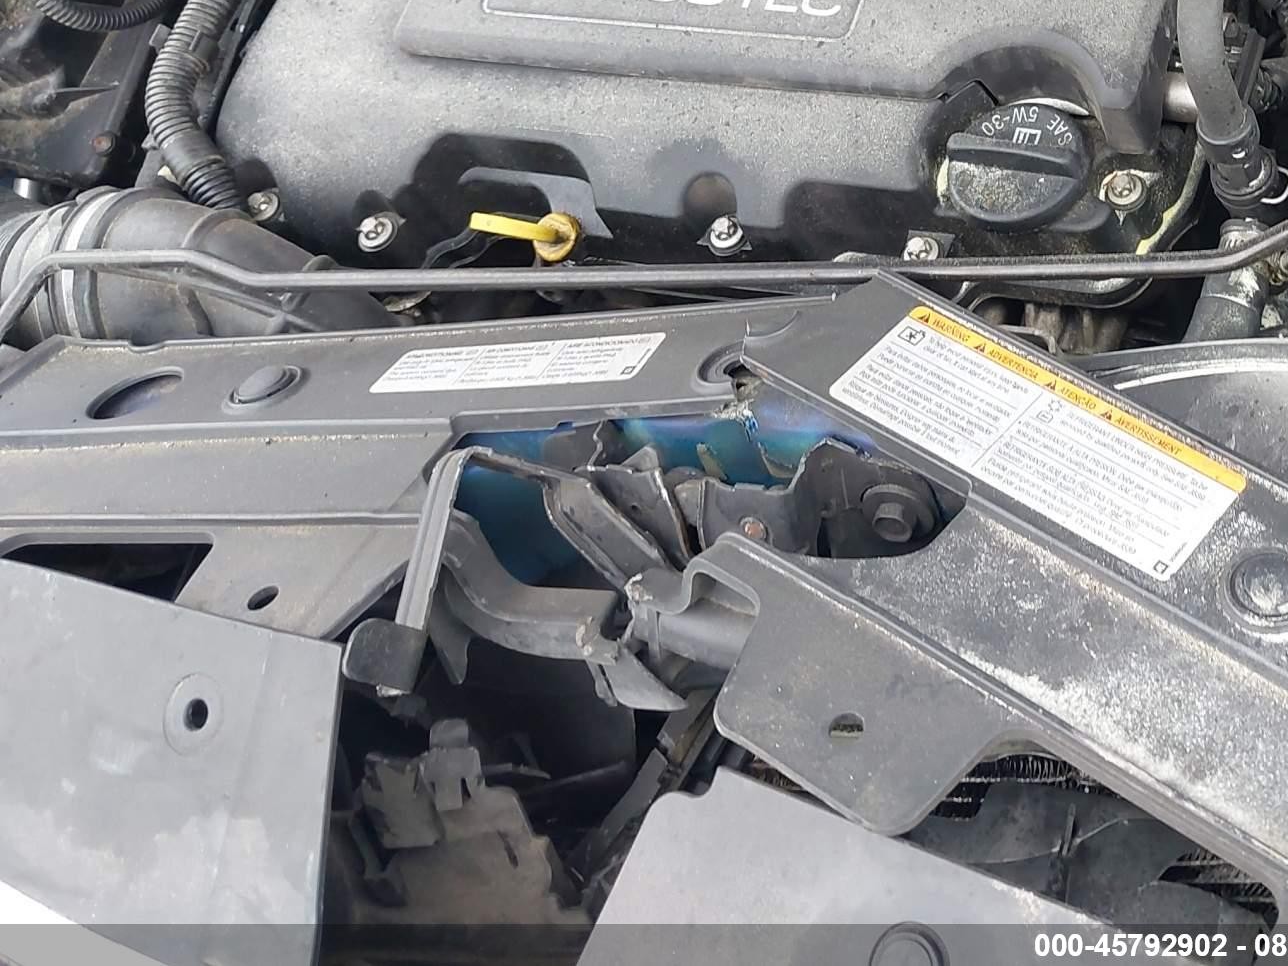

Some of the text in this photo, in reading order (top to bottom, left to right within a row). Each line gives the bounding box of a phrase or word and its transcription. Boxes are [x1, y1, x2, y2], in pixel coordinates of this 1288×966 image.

[981, 105, 1073, 146] SAE 5W-30
[929, 318, 971, 344] WARNING
[985, 348, 1041, 380] ADVERTENCIA
[1113, 415, 1184, 456] AVERTISSEMENT
